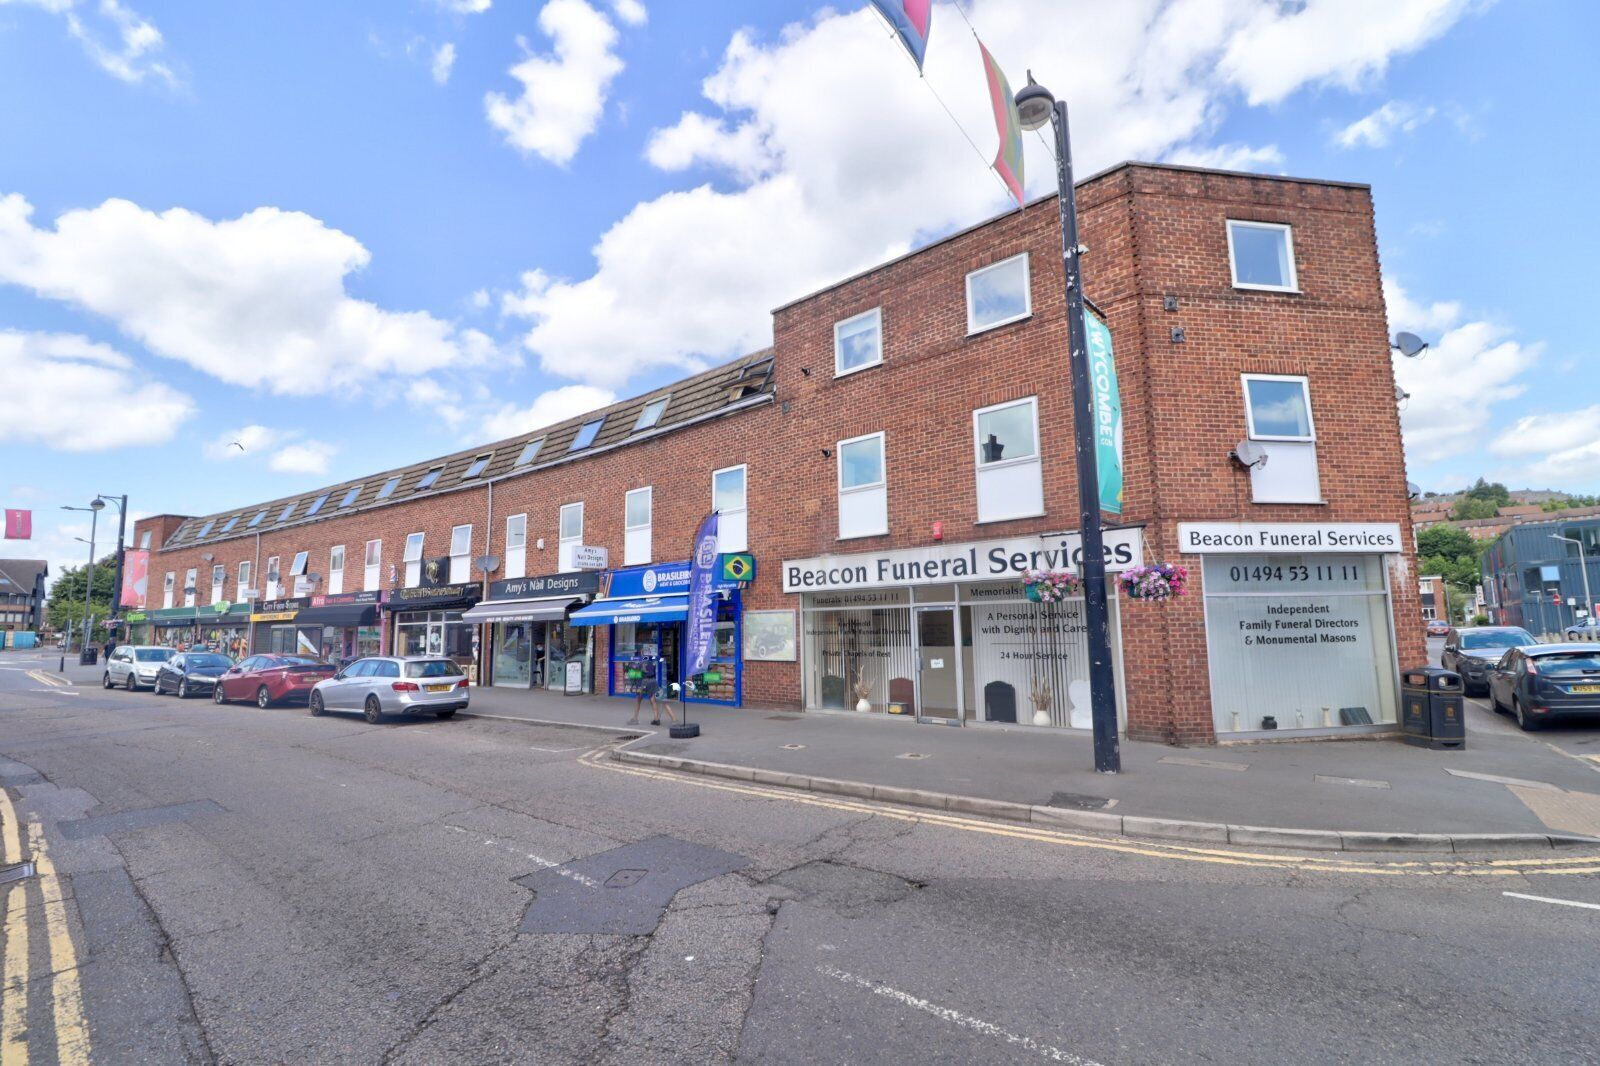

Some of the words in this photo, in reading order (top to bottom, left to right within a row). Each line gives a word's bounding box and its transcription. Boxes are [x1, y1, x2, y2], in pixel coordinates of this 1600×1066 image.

[1190, 531, 1253, 546] Beacon
[1260, 530, 1322, 546] Funeral
[1328, 531, 1394, 546] Services
[788, 565, 868, 587] Beacon
[877, 547, 977, 581] Funeral
[1230, 565, 1283, 581] 01494
[1289, 565, 1309, 581] 53
[1317, 565, 1333, 581] 11
[1342, 565, 1358, 581] 11
[505, 582, 527, 595] Amy's
[529, 579, 544, 590] Nail
[547, 577, 579, 592] Designs
[970, 586, 1022, 597] Memorials:
[987, 612, 994, 620] A
[996, 610, 1038, 620] Personal
[1040, 610, 1079, 620] Service
[1267, 604, 1330, 616] Independent
[696, 573, 713, 669] BRASILEIRO
[1239, 620, 1272, 632] Family
[1275, 619, 1311, 630] Funeral
[1315, 618, 1359, 629] Directors
[981, 625, 1000, 634] with
[1003, 624, 1036, 636] Dignity
[1040, 624, 1059, 633] and
[1062, 623, 1088, 633] Care
[1244, 635, 1253, 646] &
[1256, 634, 1317, 645] Monumental
[1320, 634, 1357, 644] Masons
[1000, 651, 1010, 660] 24
[1013, 652, 1032, 660] Hour
[1035, 651, 1068, 660] Service
